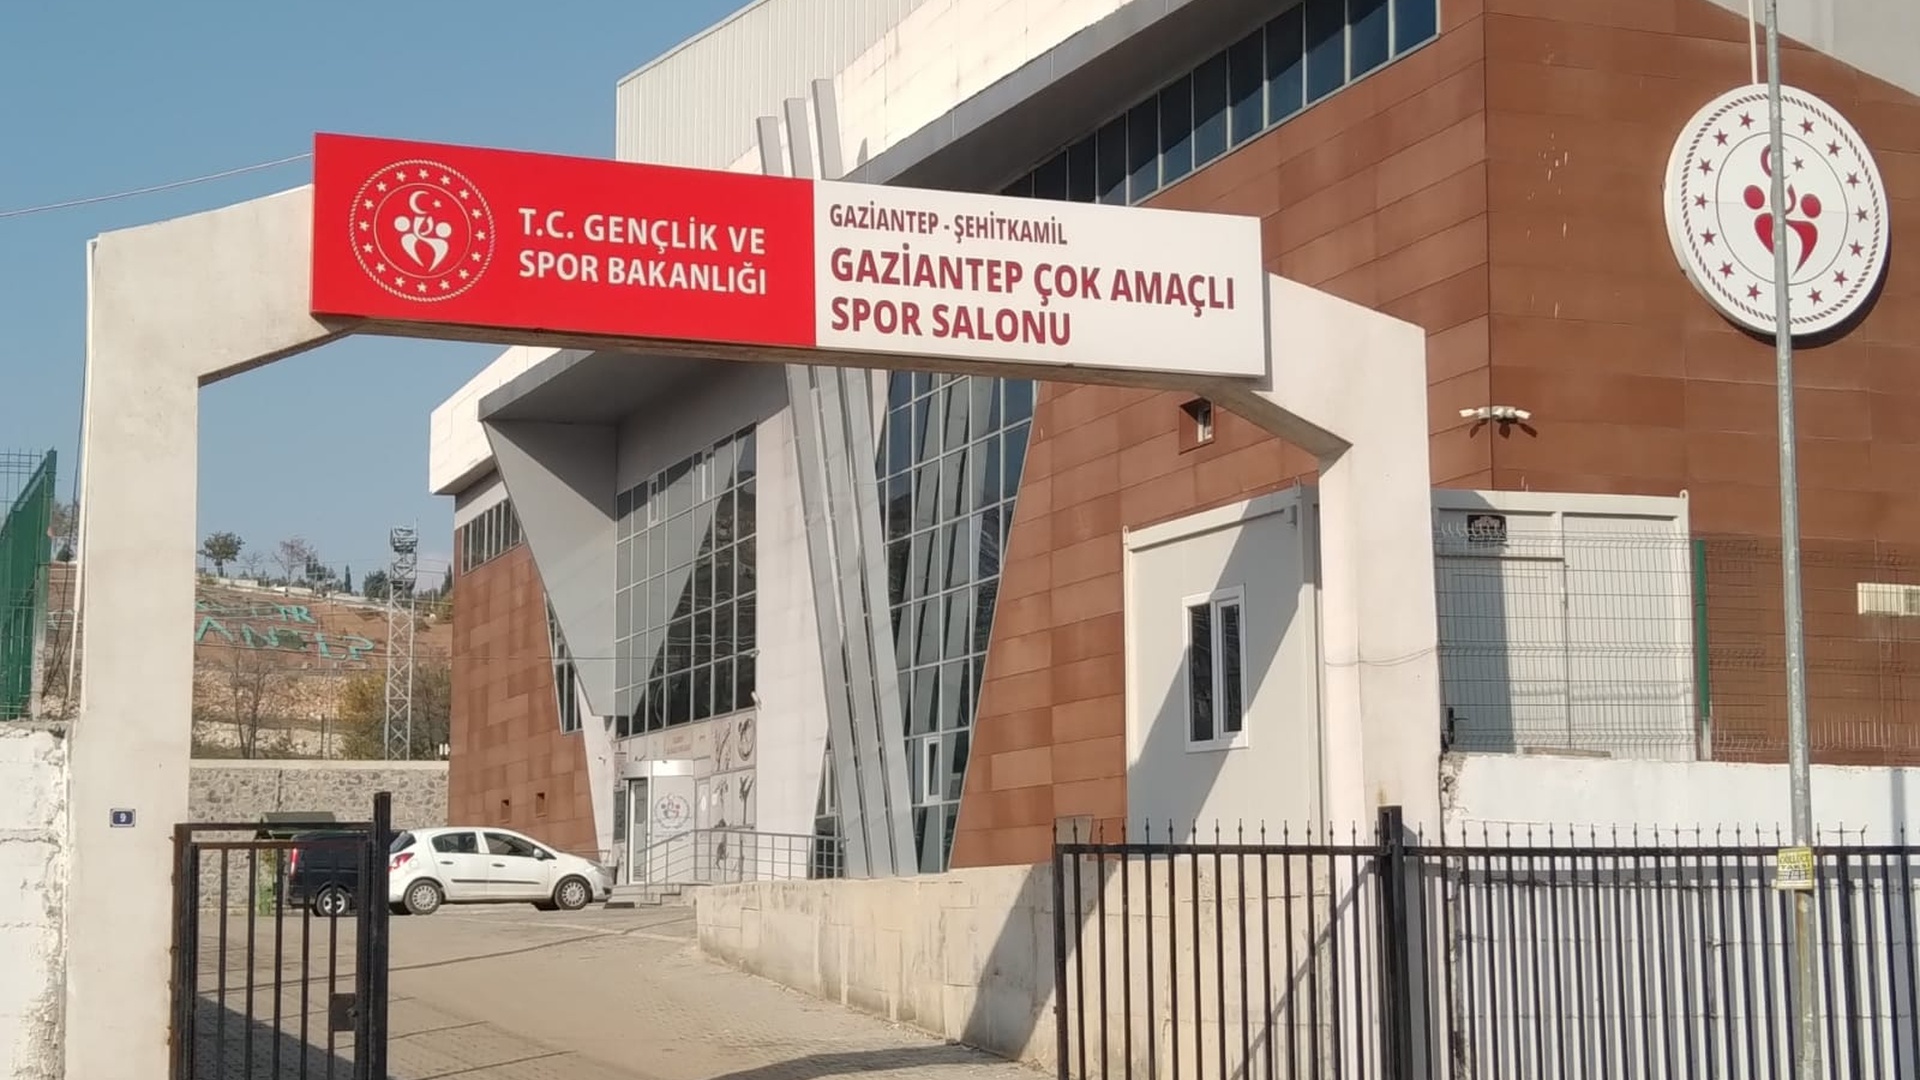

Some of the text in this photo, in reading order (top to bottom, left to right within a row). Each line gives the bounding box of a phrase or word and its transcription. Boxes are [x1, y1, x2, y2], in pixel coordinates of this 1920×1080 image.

[518, 208, 766, 256] T.C. GENÇLİK VE
[829, 201, 939, 235] GAZİANTEP
[955, 212, 1068, 246] ŞEHİTKAMİL
[520, 250, 767, 296] SPOR BAKANLIĞI
[831, 243, 1235, 317] GAZİANTEP ÇOK AMAÇLI
[831, 297, 1071, 346] SPOR SALONU
[119, 812, 127, 823] 9
